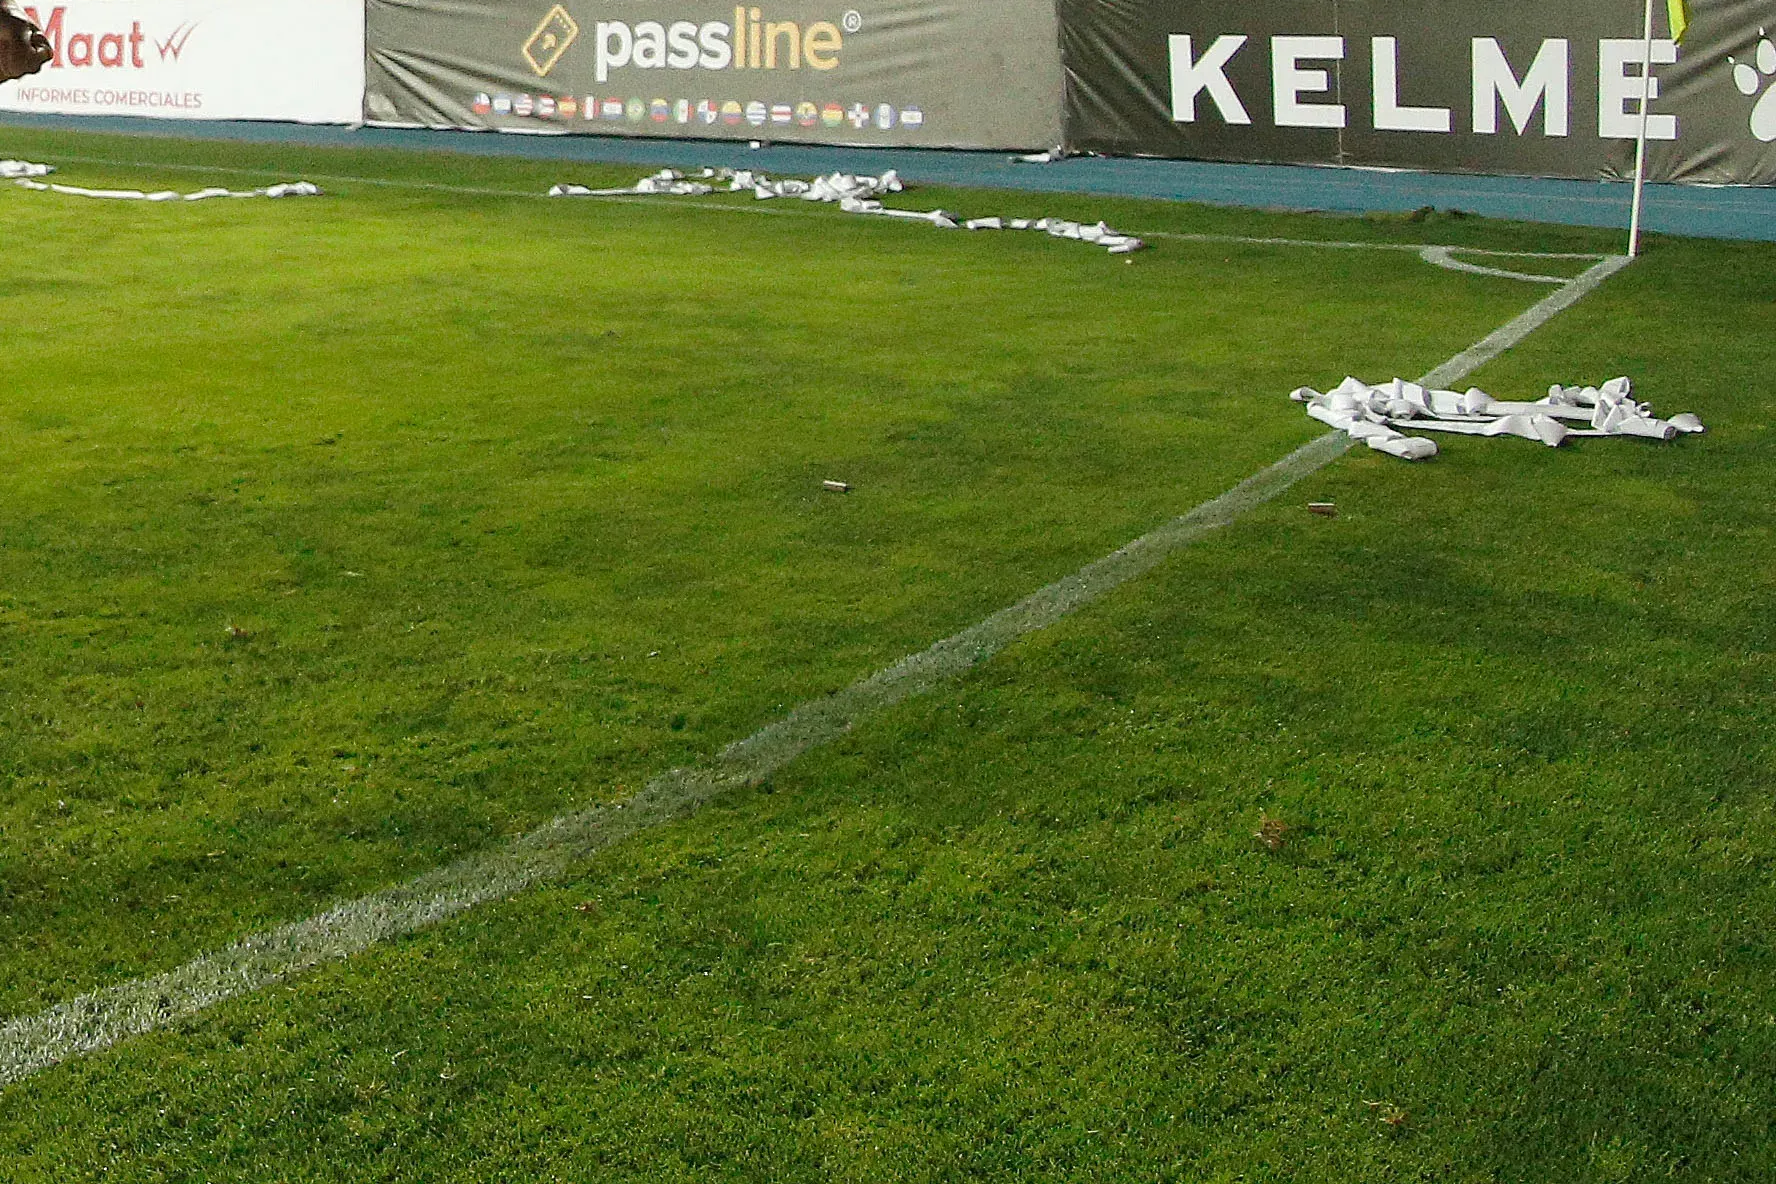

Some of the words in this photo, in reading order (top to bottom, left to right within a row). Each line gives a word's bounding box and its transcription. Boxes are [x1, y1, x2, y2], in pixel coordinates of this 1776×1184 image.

[24, 6, 145, 69] Maat
[594, 5, 843, 83] passline
[17, 88, 89, 105] INFORMES
[94, 89, 202, 108] COMERCIALES
[1167, 33, 1680, 141] KELME
